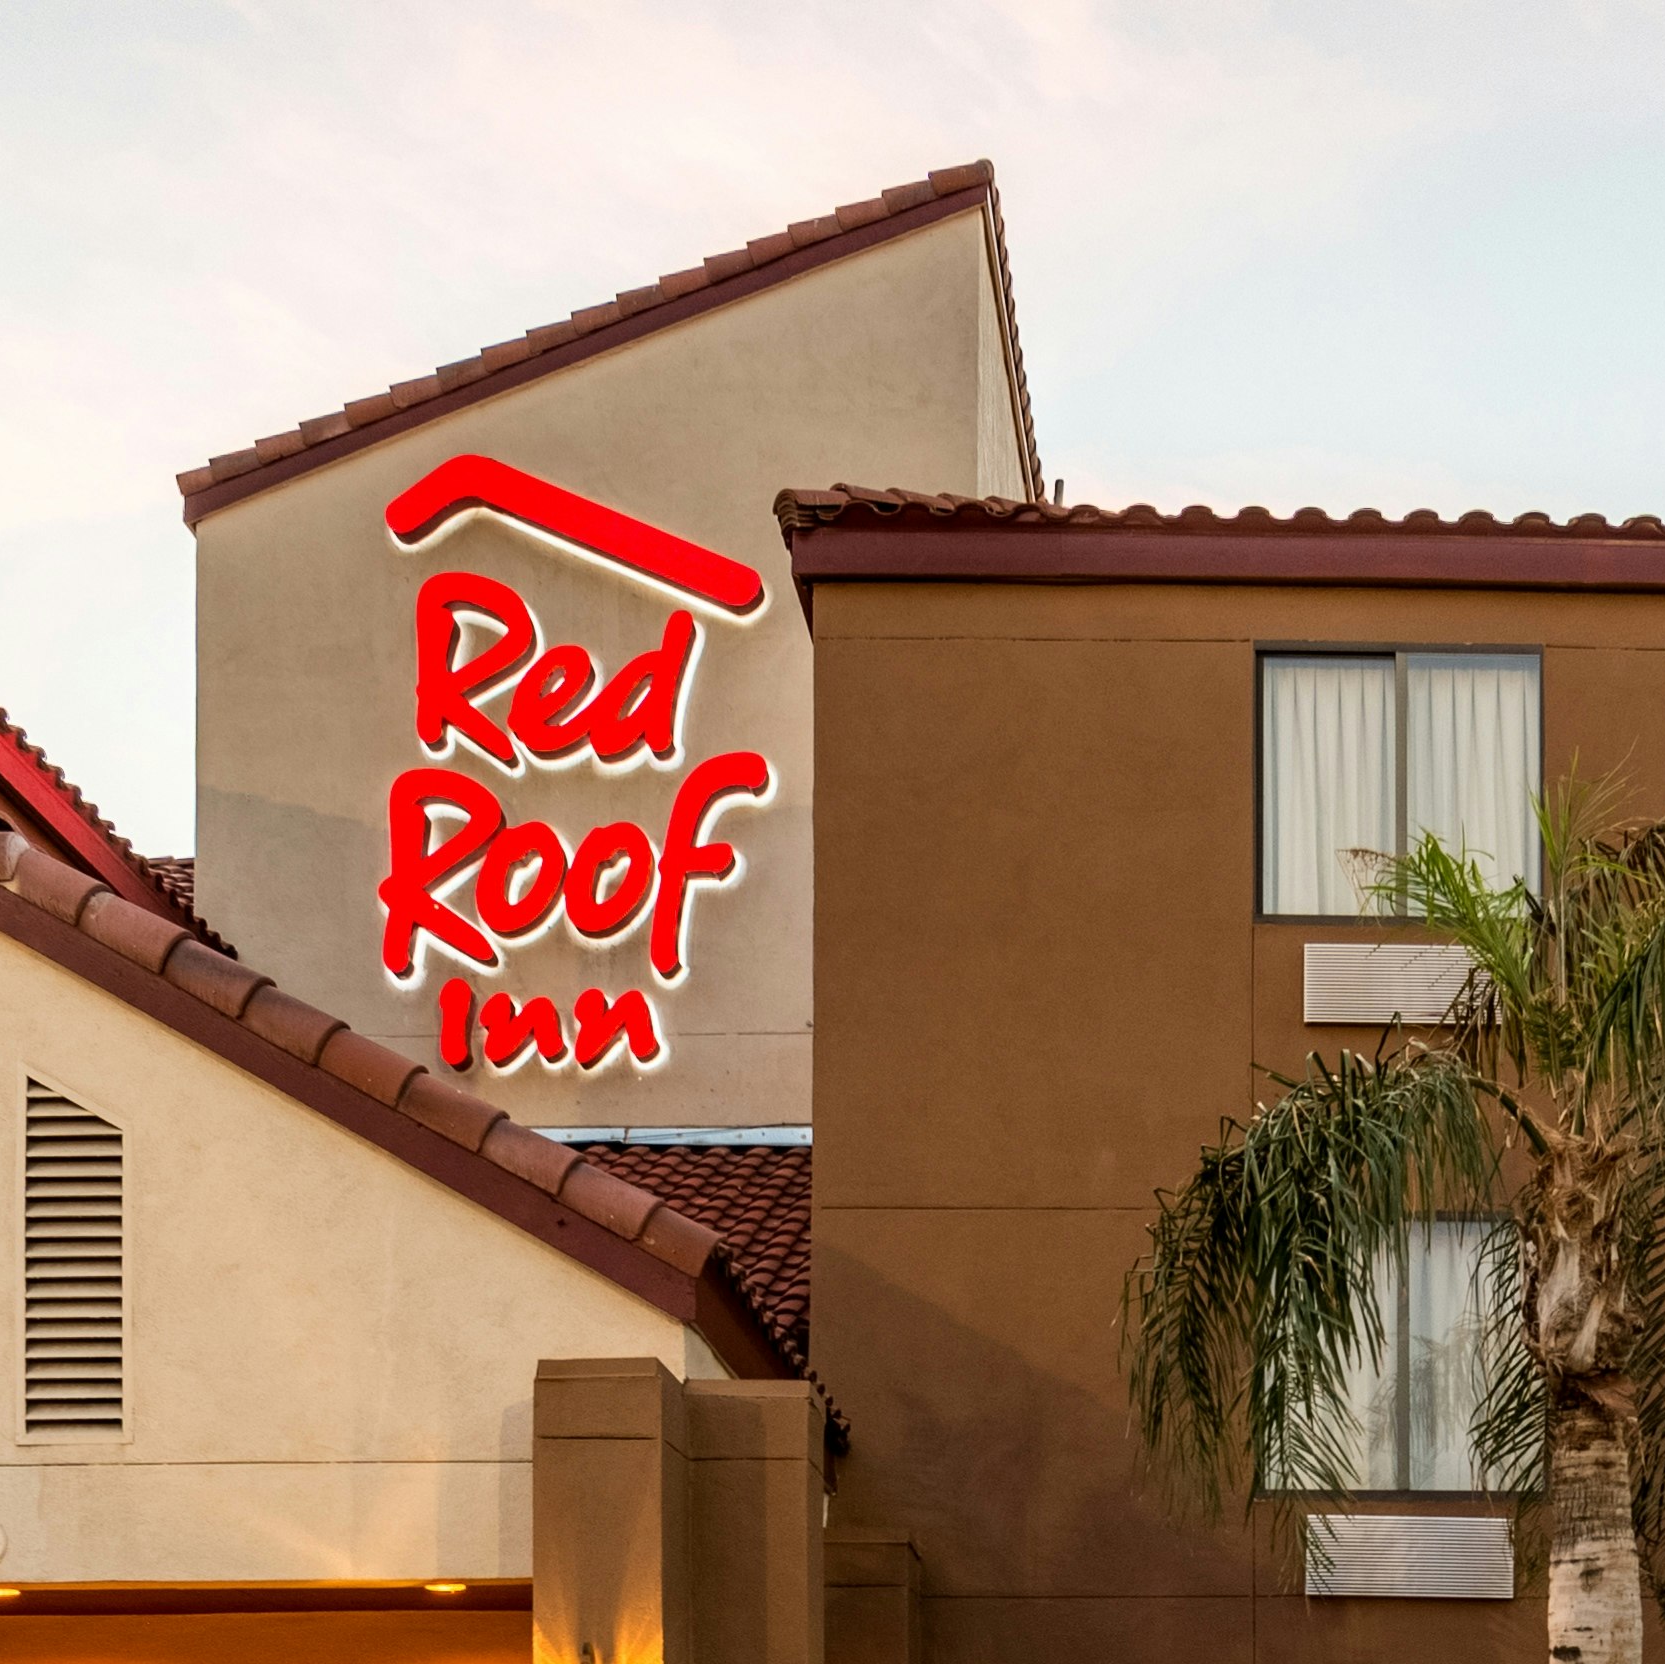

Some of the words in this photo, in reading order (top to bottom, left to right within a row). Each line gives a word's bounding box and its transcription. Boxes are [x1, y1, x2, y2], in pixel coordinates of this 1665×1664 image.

[415, 572, 695, 764] Red
[378, 751, 770, 978] Roof
[438, 977, 662, 1068] Inn
